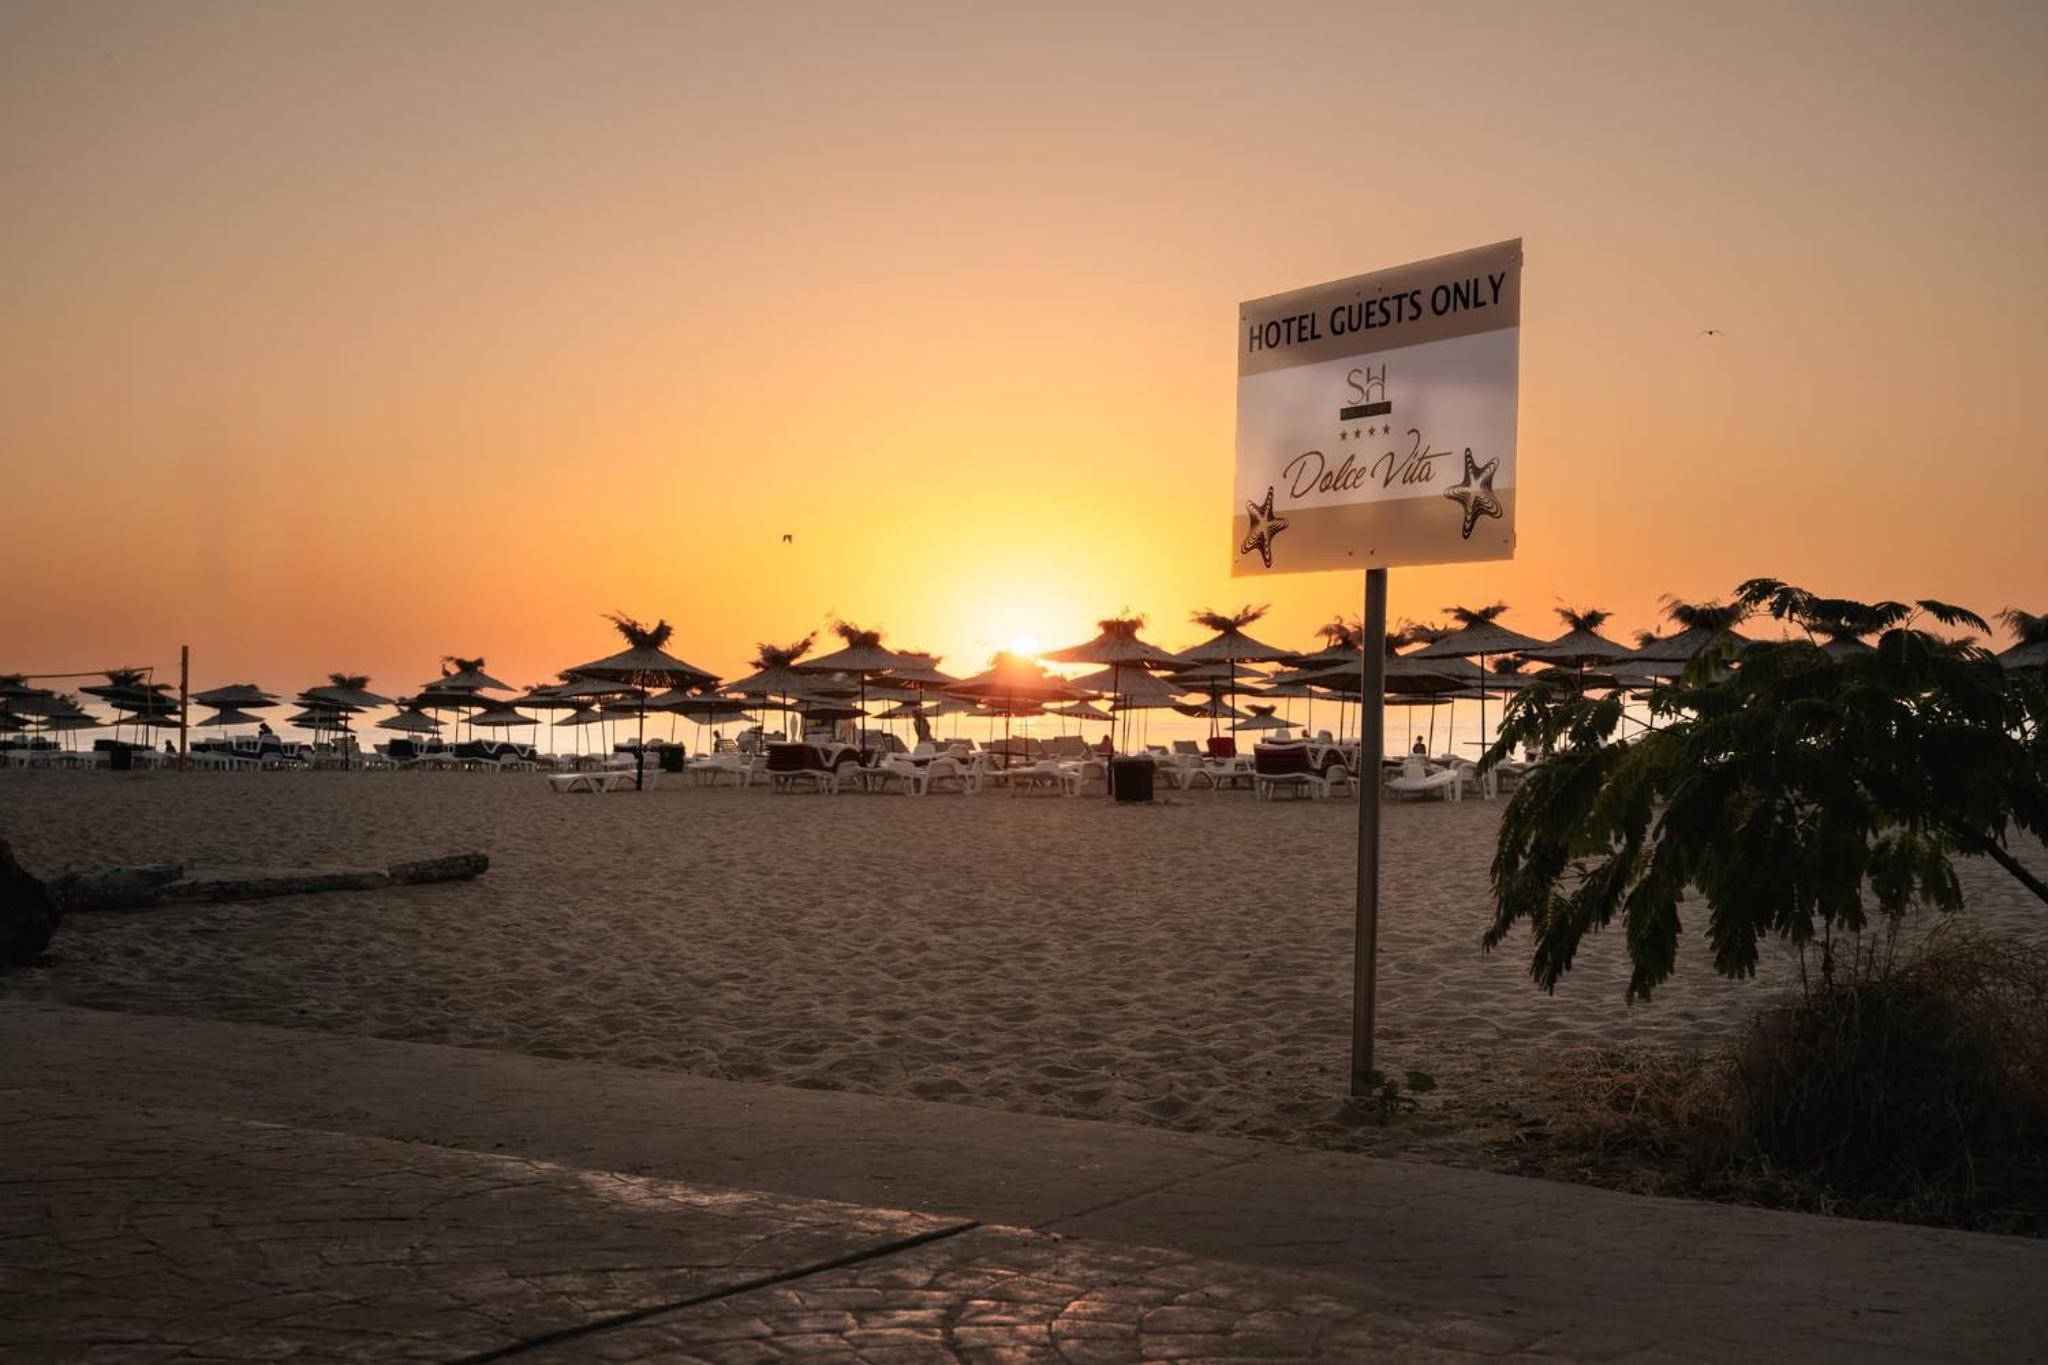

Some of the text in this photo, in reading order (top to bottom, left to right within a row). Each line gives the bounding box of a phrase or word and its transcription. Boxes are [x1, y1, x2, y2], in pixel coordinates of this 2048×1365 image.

[1249, 272, 1506, 352] HOTEL GUESTS ONLY
[1347, 364, 1386, 405] SH
[1282, 428, 1453, 500] Dolce Vita
